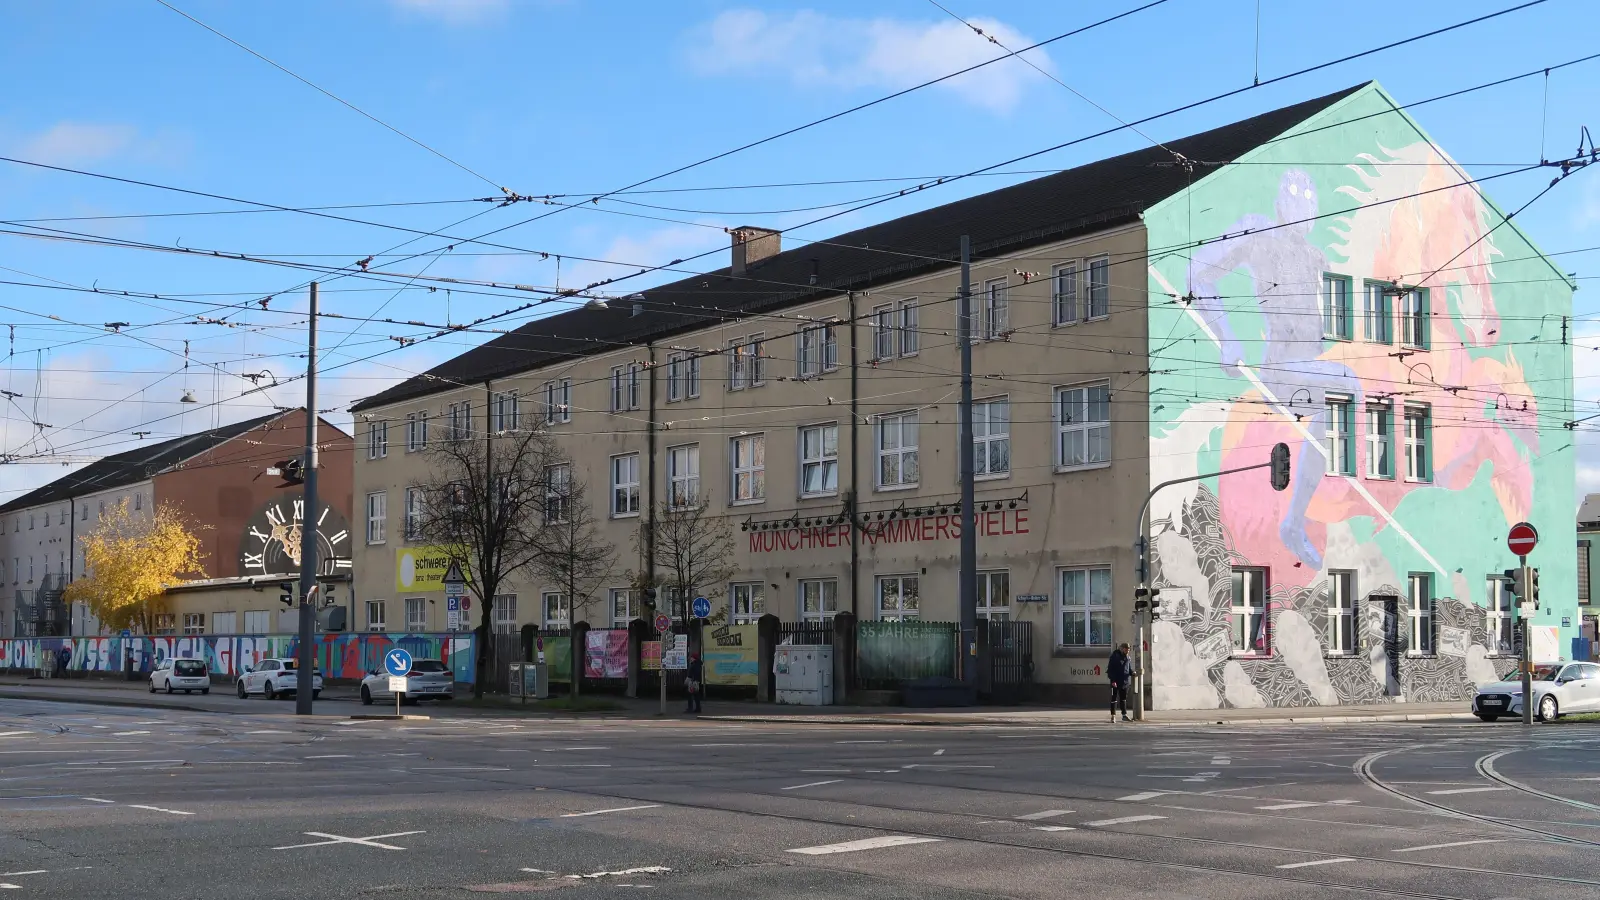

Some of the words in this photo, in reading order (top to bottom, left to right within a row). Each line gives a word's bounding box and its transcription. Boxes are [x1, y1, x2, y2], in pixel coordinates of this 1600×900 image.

[862, 509, 1029, 545] KAMMERSIELE
[415, 556, 446, 569] schwere
[449, 598, 456, 610] P
[861, 626, 875, 638] 35
[878, 626, 919, 639] JAHRE
